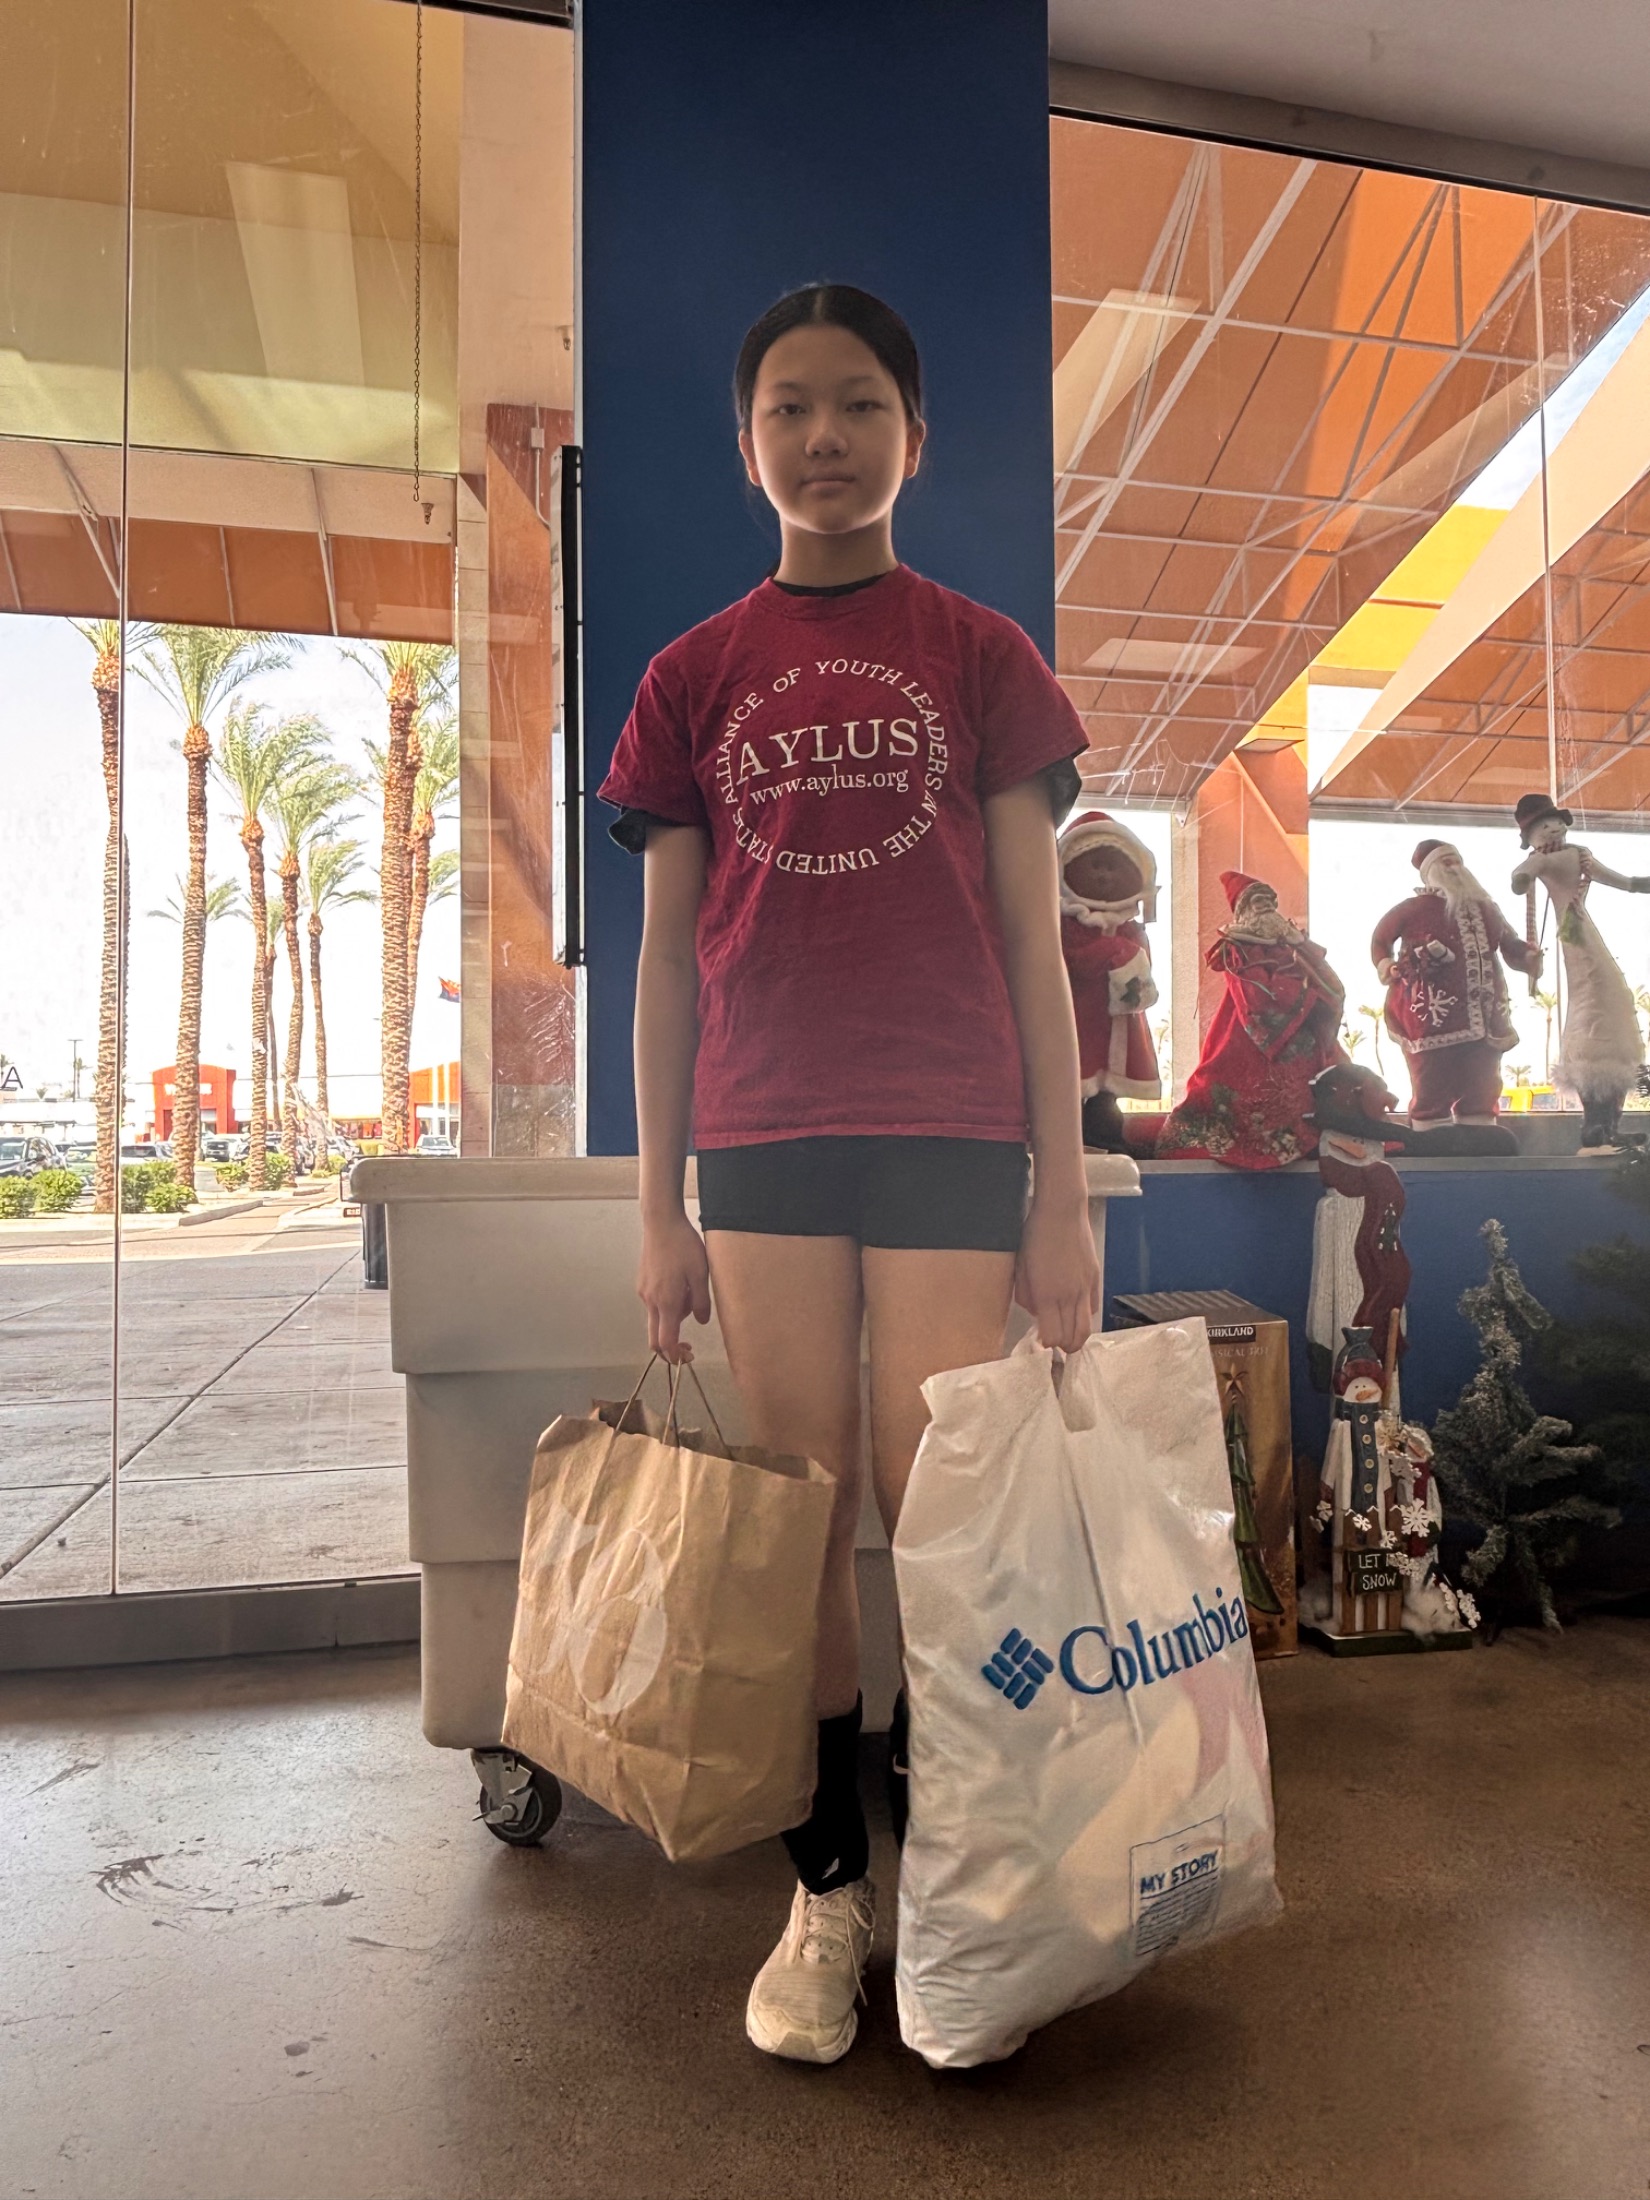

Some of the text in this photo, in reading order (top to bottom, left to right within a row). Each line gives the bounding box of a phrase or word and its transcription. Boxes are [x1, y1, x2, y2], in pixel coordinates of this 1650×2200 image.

[772, 668, 802, 693] OF
[815, 658, 903, 685] YOUTH
[716, 692, 764, 804] ALLIANCE
[736, 717, 920, 786] AYLUS
[900, 681, 949, 791] LEADERS
[750, 764, 910, 805] www.aylus.org
[732, 807, 774, 865] STATS
[883, 815, 932, 859] THE
[775, 848, 880, 875] UNITED
[1207, 1327, 1254, 1338] KIRKLAND
[1358, 1553, 1381, 1569] LET
[1362, 1572, 1397, 1591] SNOW
[1059, 1586, 1249, 1694] Columbia
[1140, 1848, 1220, 1895] MY STORY
